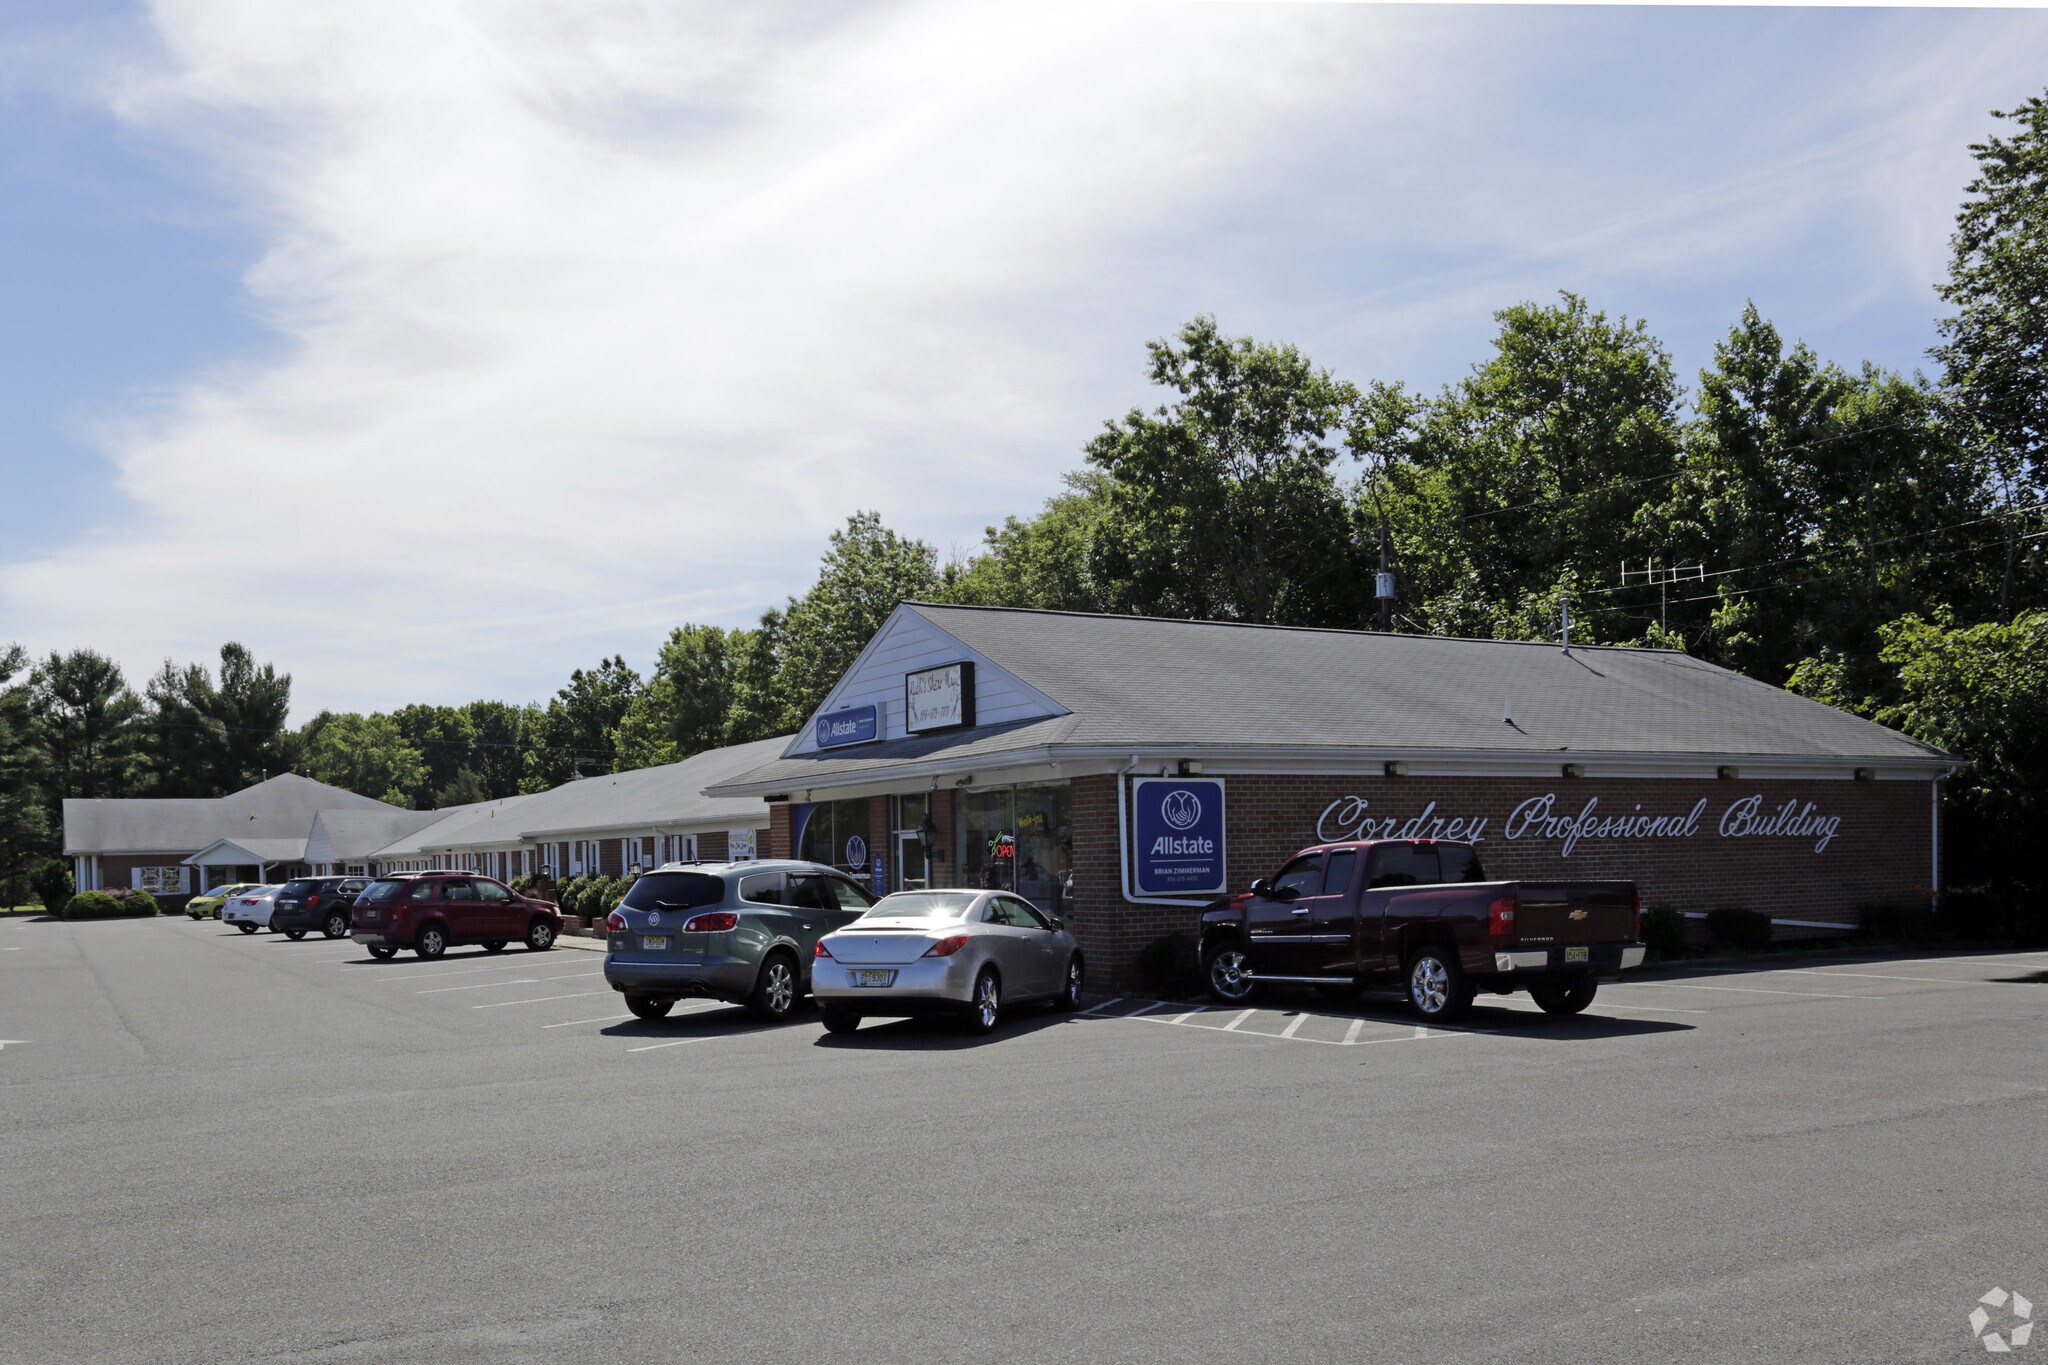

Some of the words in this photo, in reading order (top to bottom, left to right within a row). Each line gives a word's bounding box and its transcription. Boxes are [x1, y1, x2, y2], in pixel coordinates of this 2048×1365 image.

[830, 719, 857, 738] Allstate
[1316, 794, 1488, 845] Cordrey
[1504, 792, 1709, 858] Professional
[1718, 793, 1842, 854] Building
[995, 844, 1015, 858] OPEN
[1151, 836, 1213, 855] Allstate
[1173, 867, 1210, 875] ZIMMERMAN
